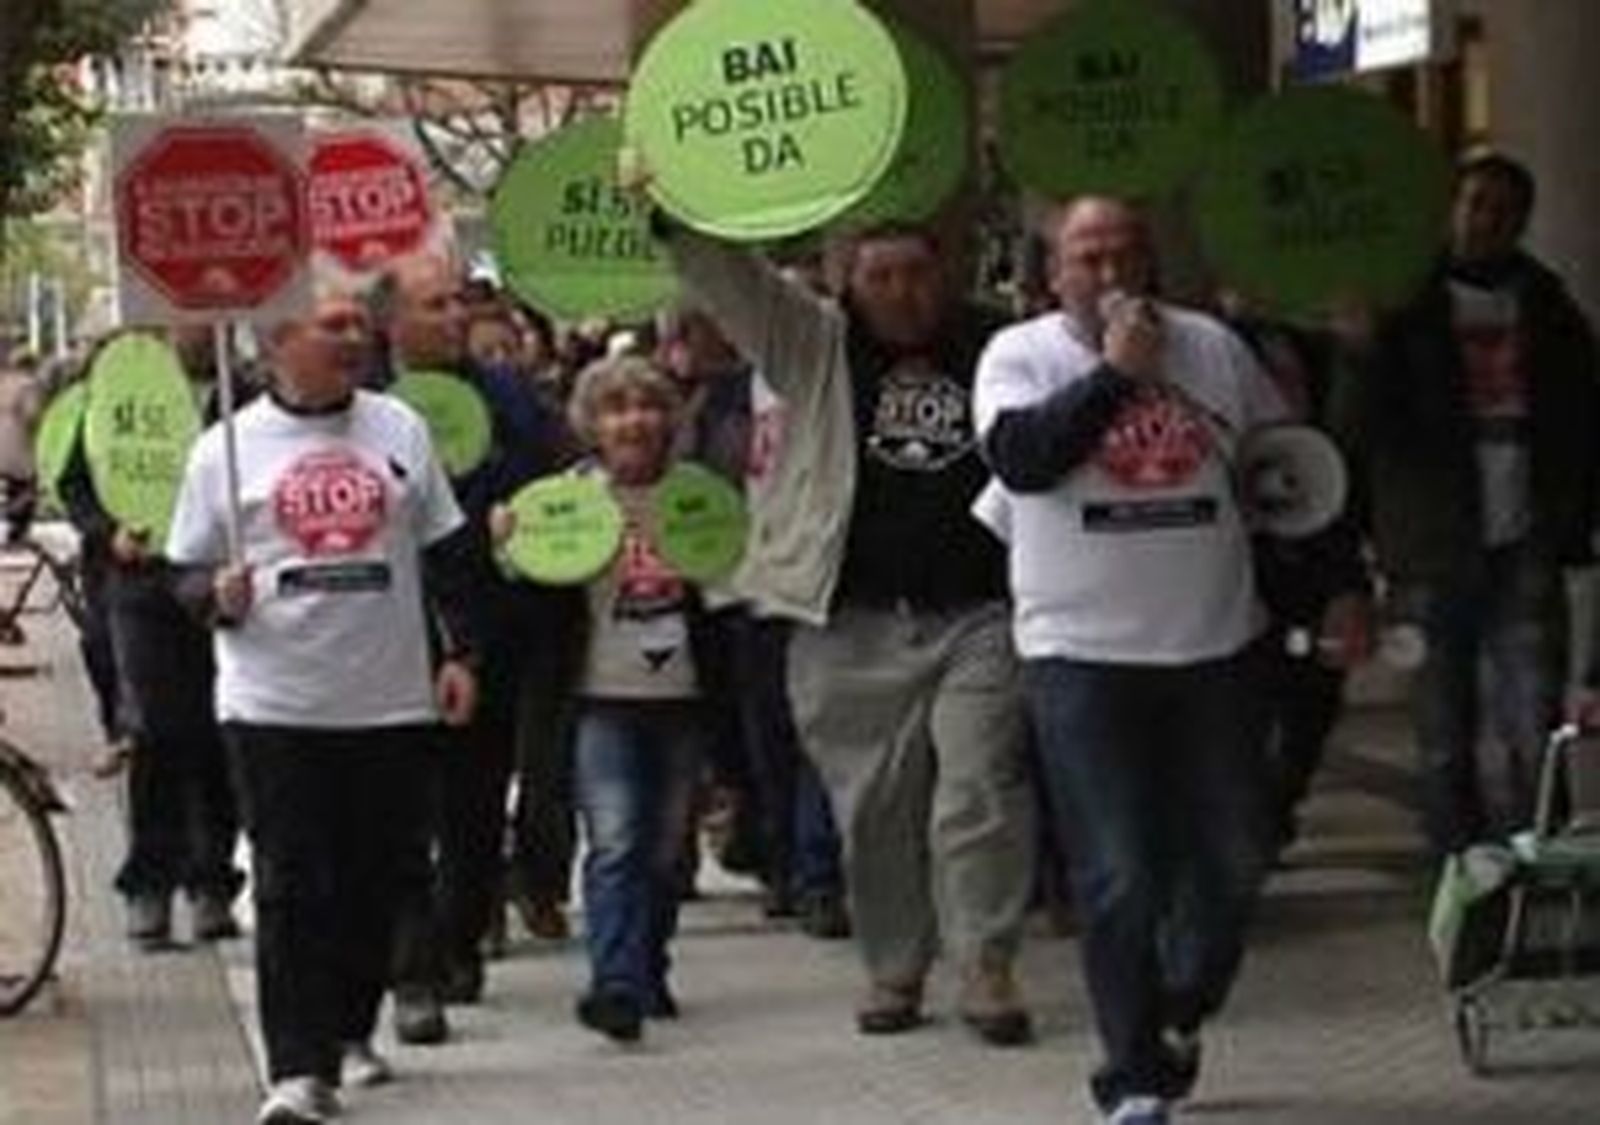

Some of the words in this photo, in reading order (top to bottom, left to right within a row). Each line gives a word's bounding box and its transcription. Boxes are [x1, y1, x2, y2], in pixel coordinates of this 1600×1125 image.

[722, 38, 797, 86] BAI
[672, 71, 863, 143] POSIBLE
[742, 132, 806, 175] DA
[137, 195, 289, 247] STOP
[307, 178, 415, 222] STOP
[877, 392, 964, 428] STOP
[280, 473, 381, 515] STOP
